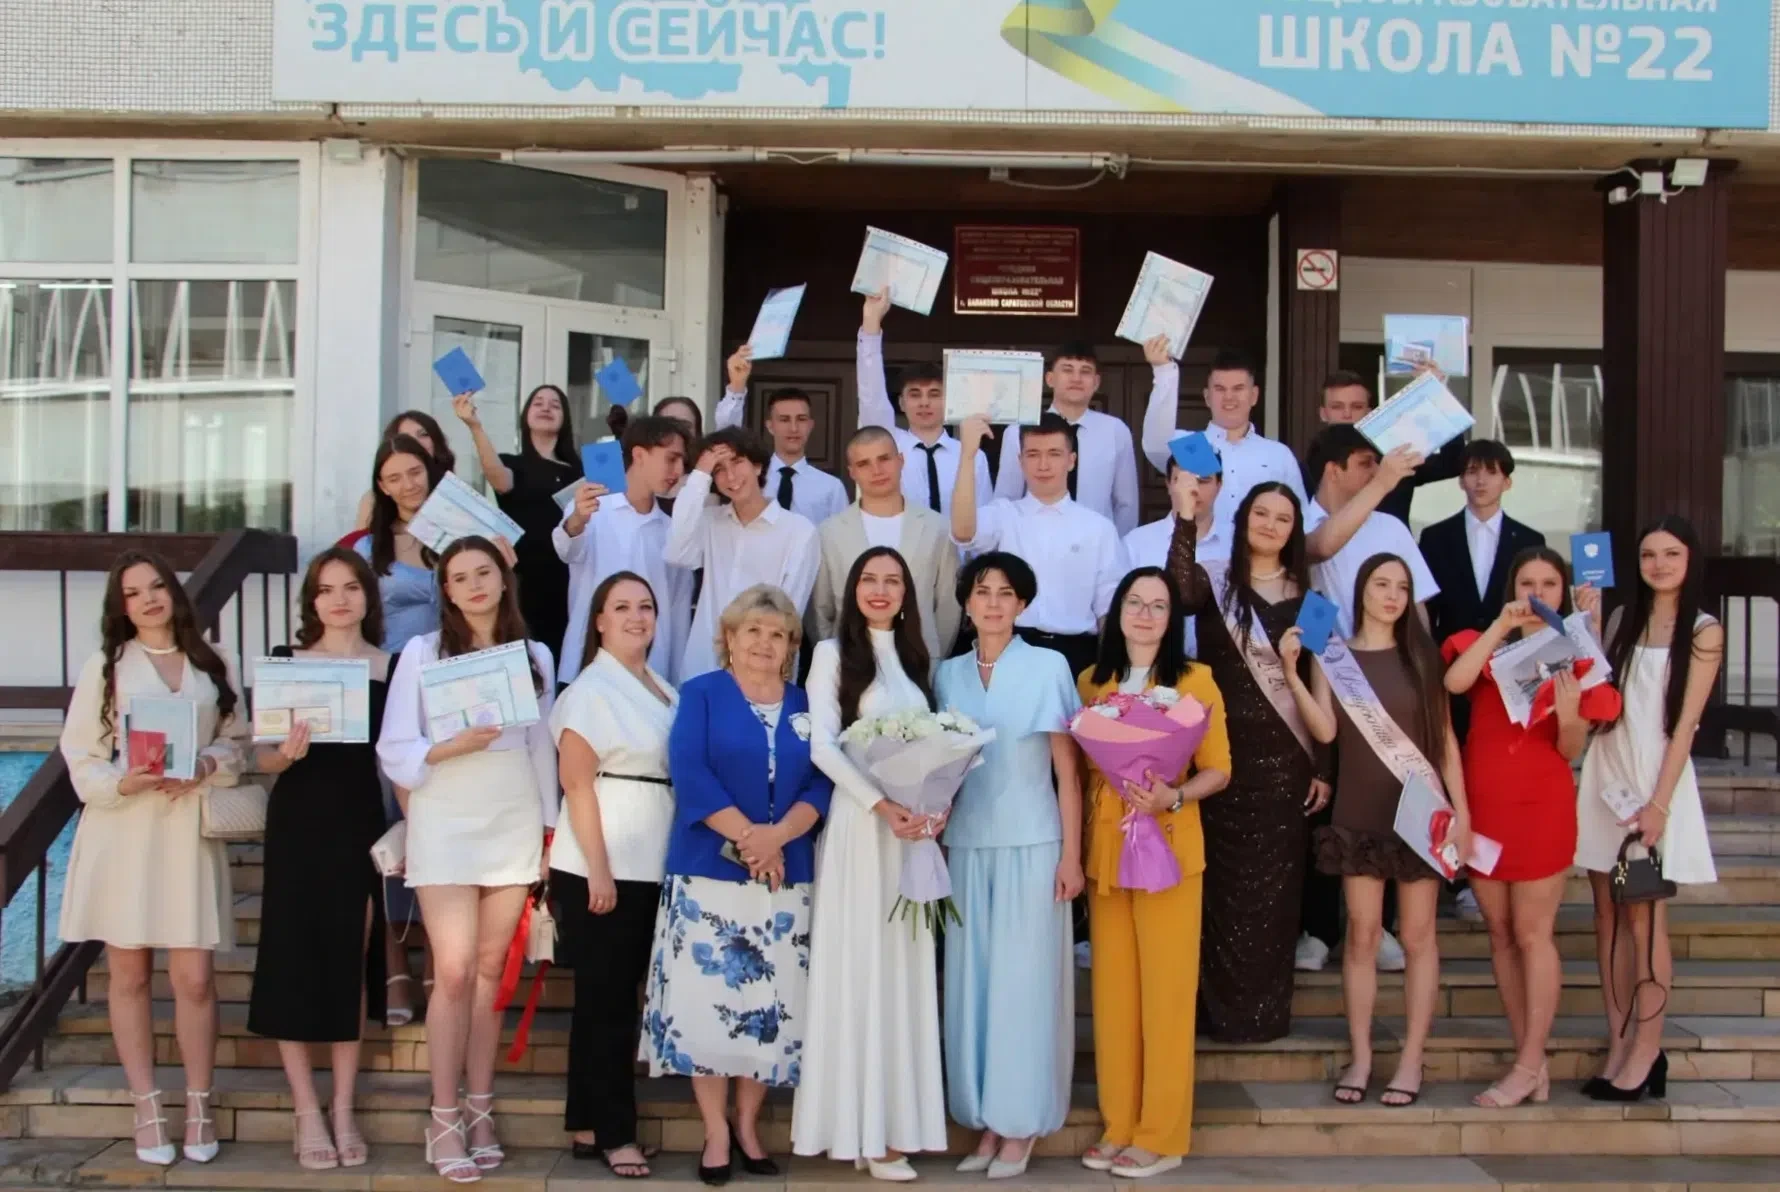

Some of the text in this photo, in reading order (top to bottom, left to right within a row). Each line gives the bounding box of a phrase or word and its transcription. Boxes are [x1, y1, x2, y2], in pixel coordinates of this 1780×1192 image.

[312, 0, 886, 62] ЗДЕСЬ И СЕЙЧАС!
[1259, 14, 1713, 81] ШКОЛА №22
